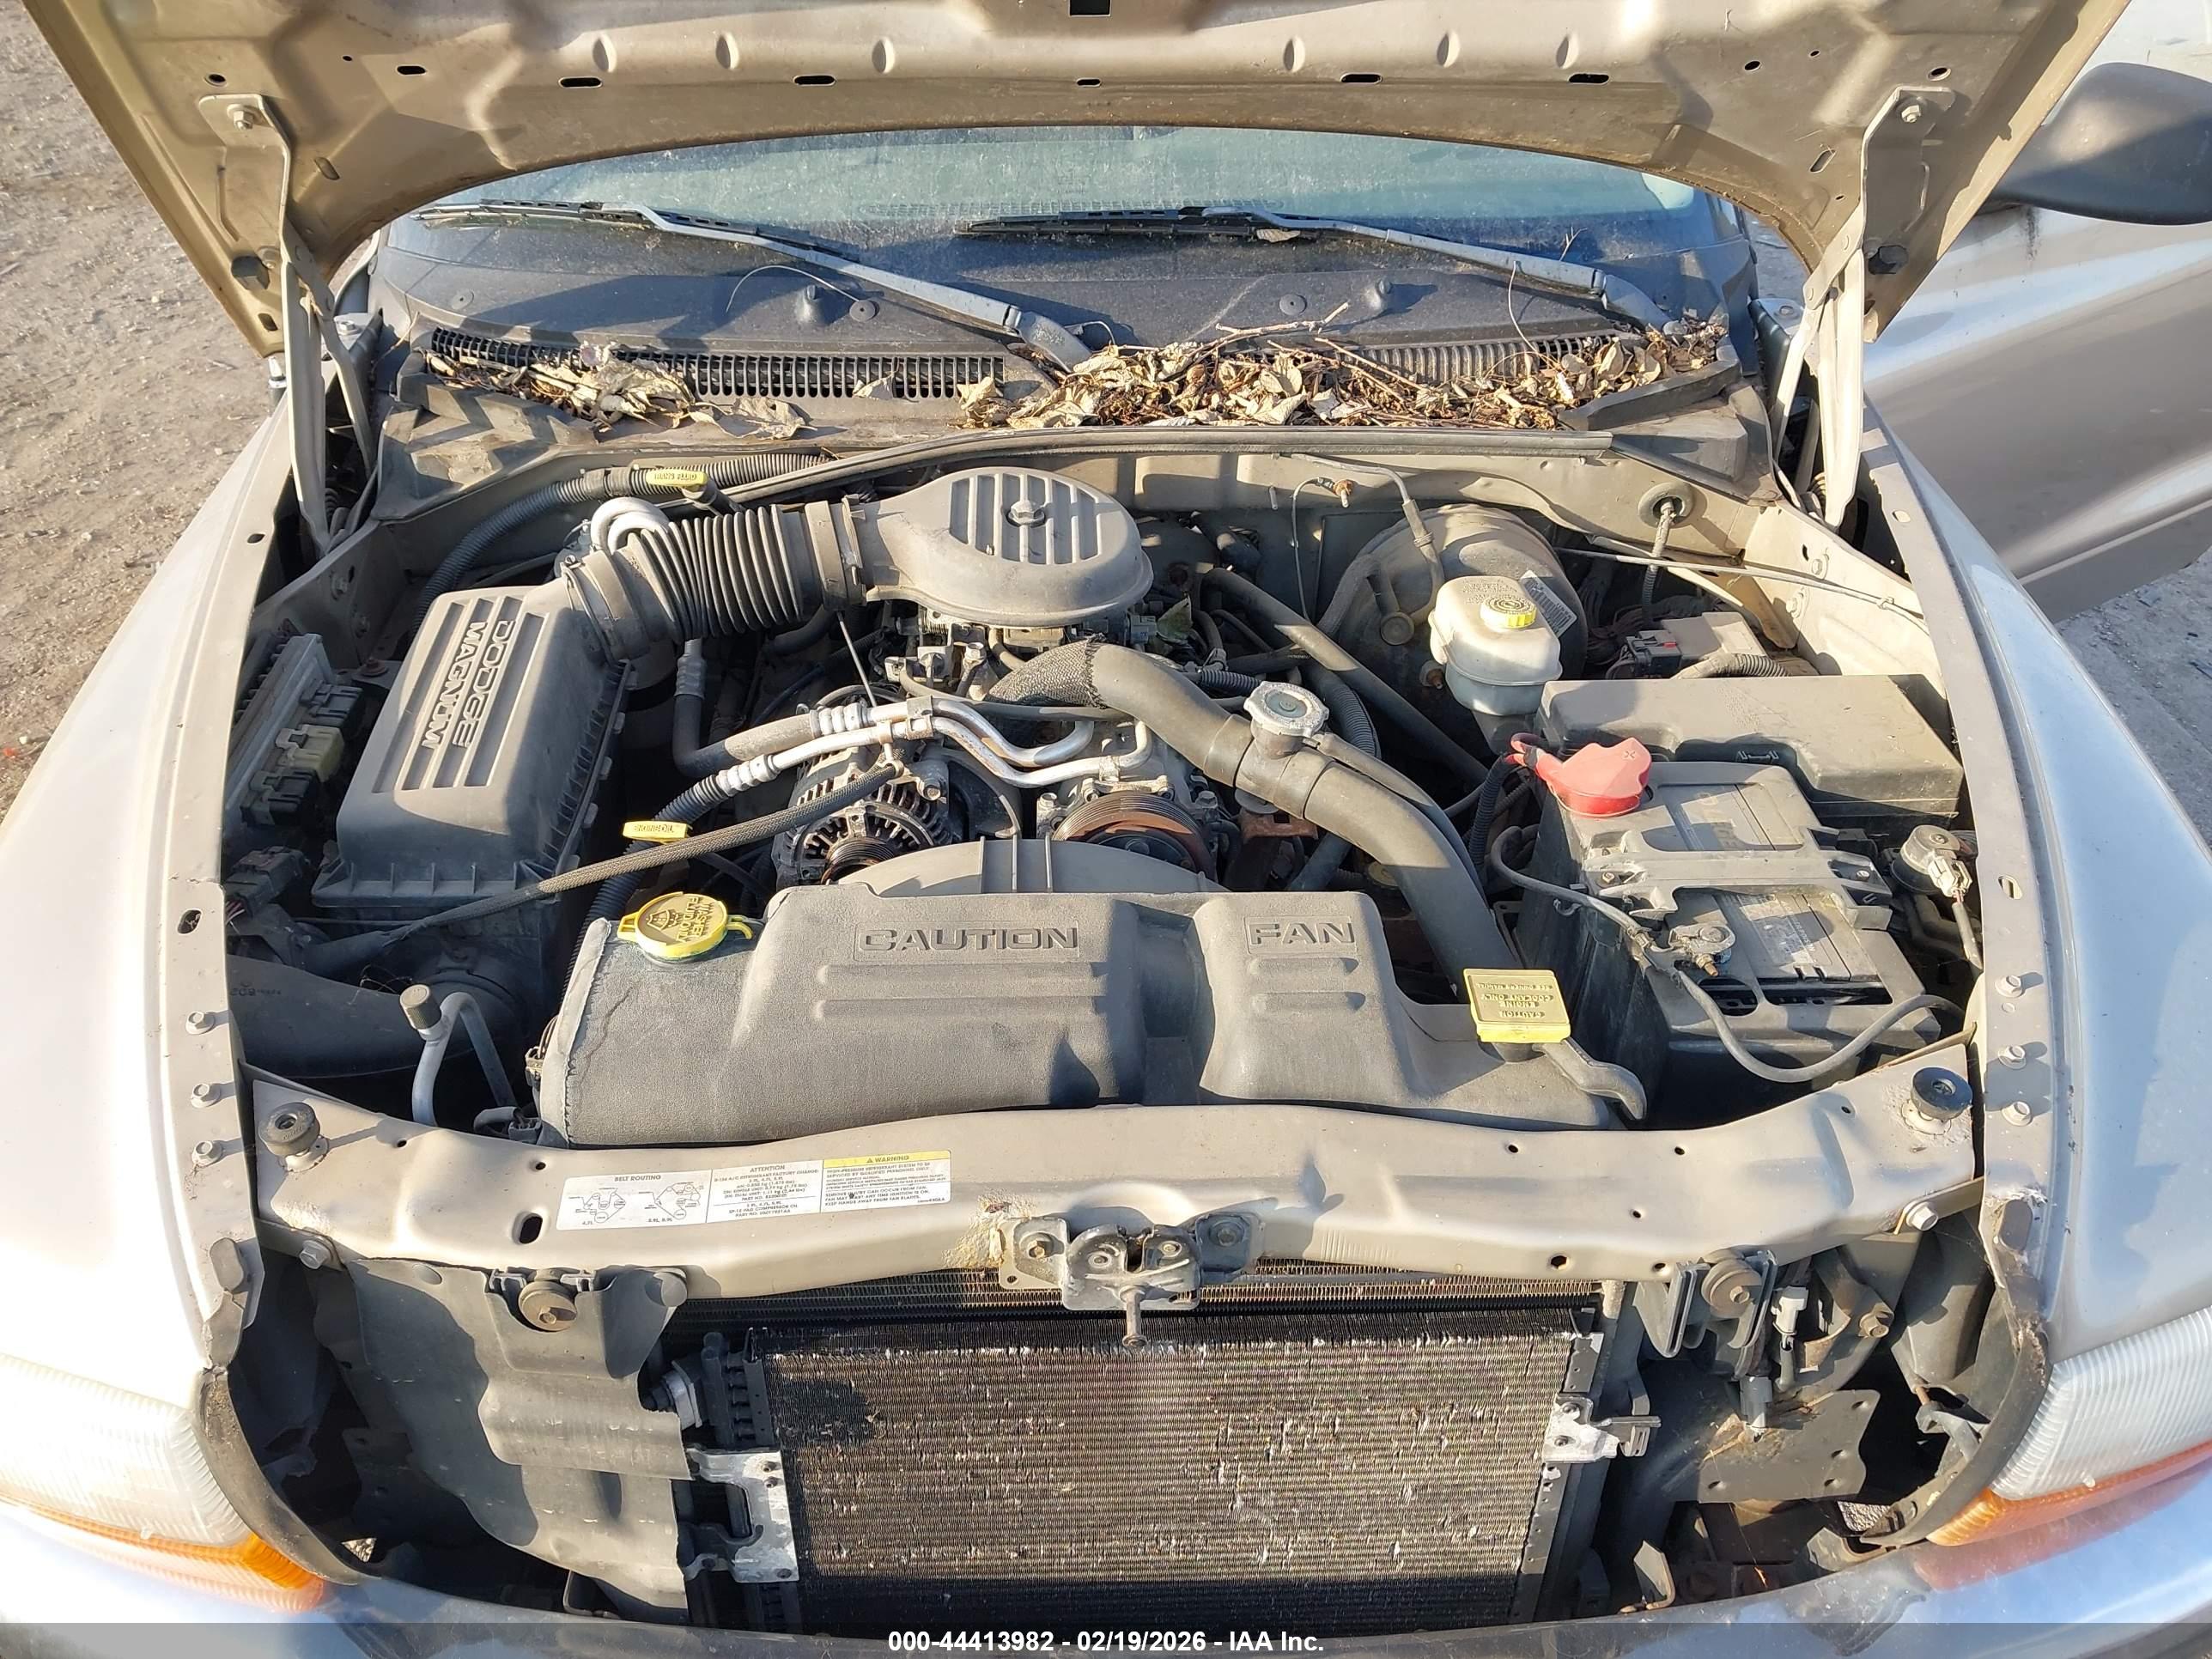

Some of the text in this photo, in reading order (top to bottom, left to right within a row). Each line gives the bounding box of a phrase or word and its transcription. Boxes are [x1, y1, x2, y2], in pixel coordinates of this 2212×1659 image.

[422, 621, 488, 750] MAGNUM
[453, 620, 516, 748] DODGE
[683, 896, 699, 920] FLUID
[858, 927, 1078, 951] CAUTION
[1249, 921, 1355, 945] FAN
